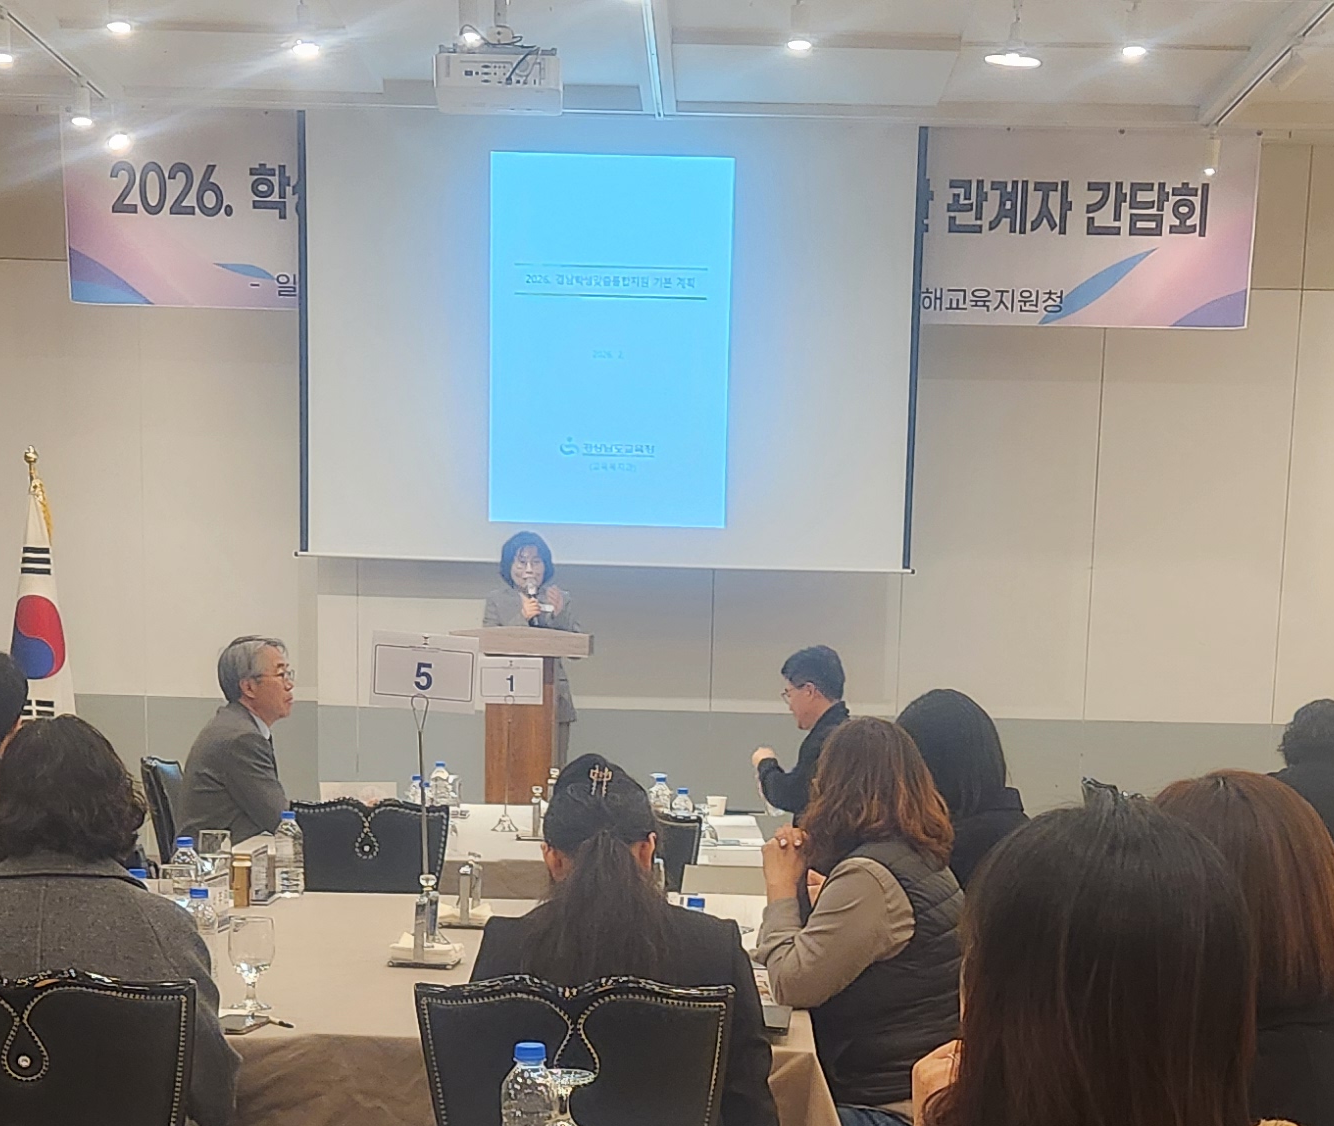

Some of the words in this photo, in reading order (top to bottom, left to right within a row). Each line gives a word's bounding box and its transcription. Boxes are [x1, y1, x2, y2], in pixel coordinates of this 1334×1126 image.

[110, 161, 234, 217] 2026.
[947, 178, 1072, 235] 관계자
[1085, 181, 1210, 237] 간담회
[526, 274, 551, 285] 2026.
[413, 662, 433, 691] 5
[505, 674, 515, 692] 1
